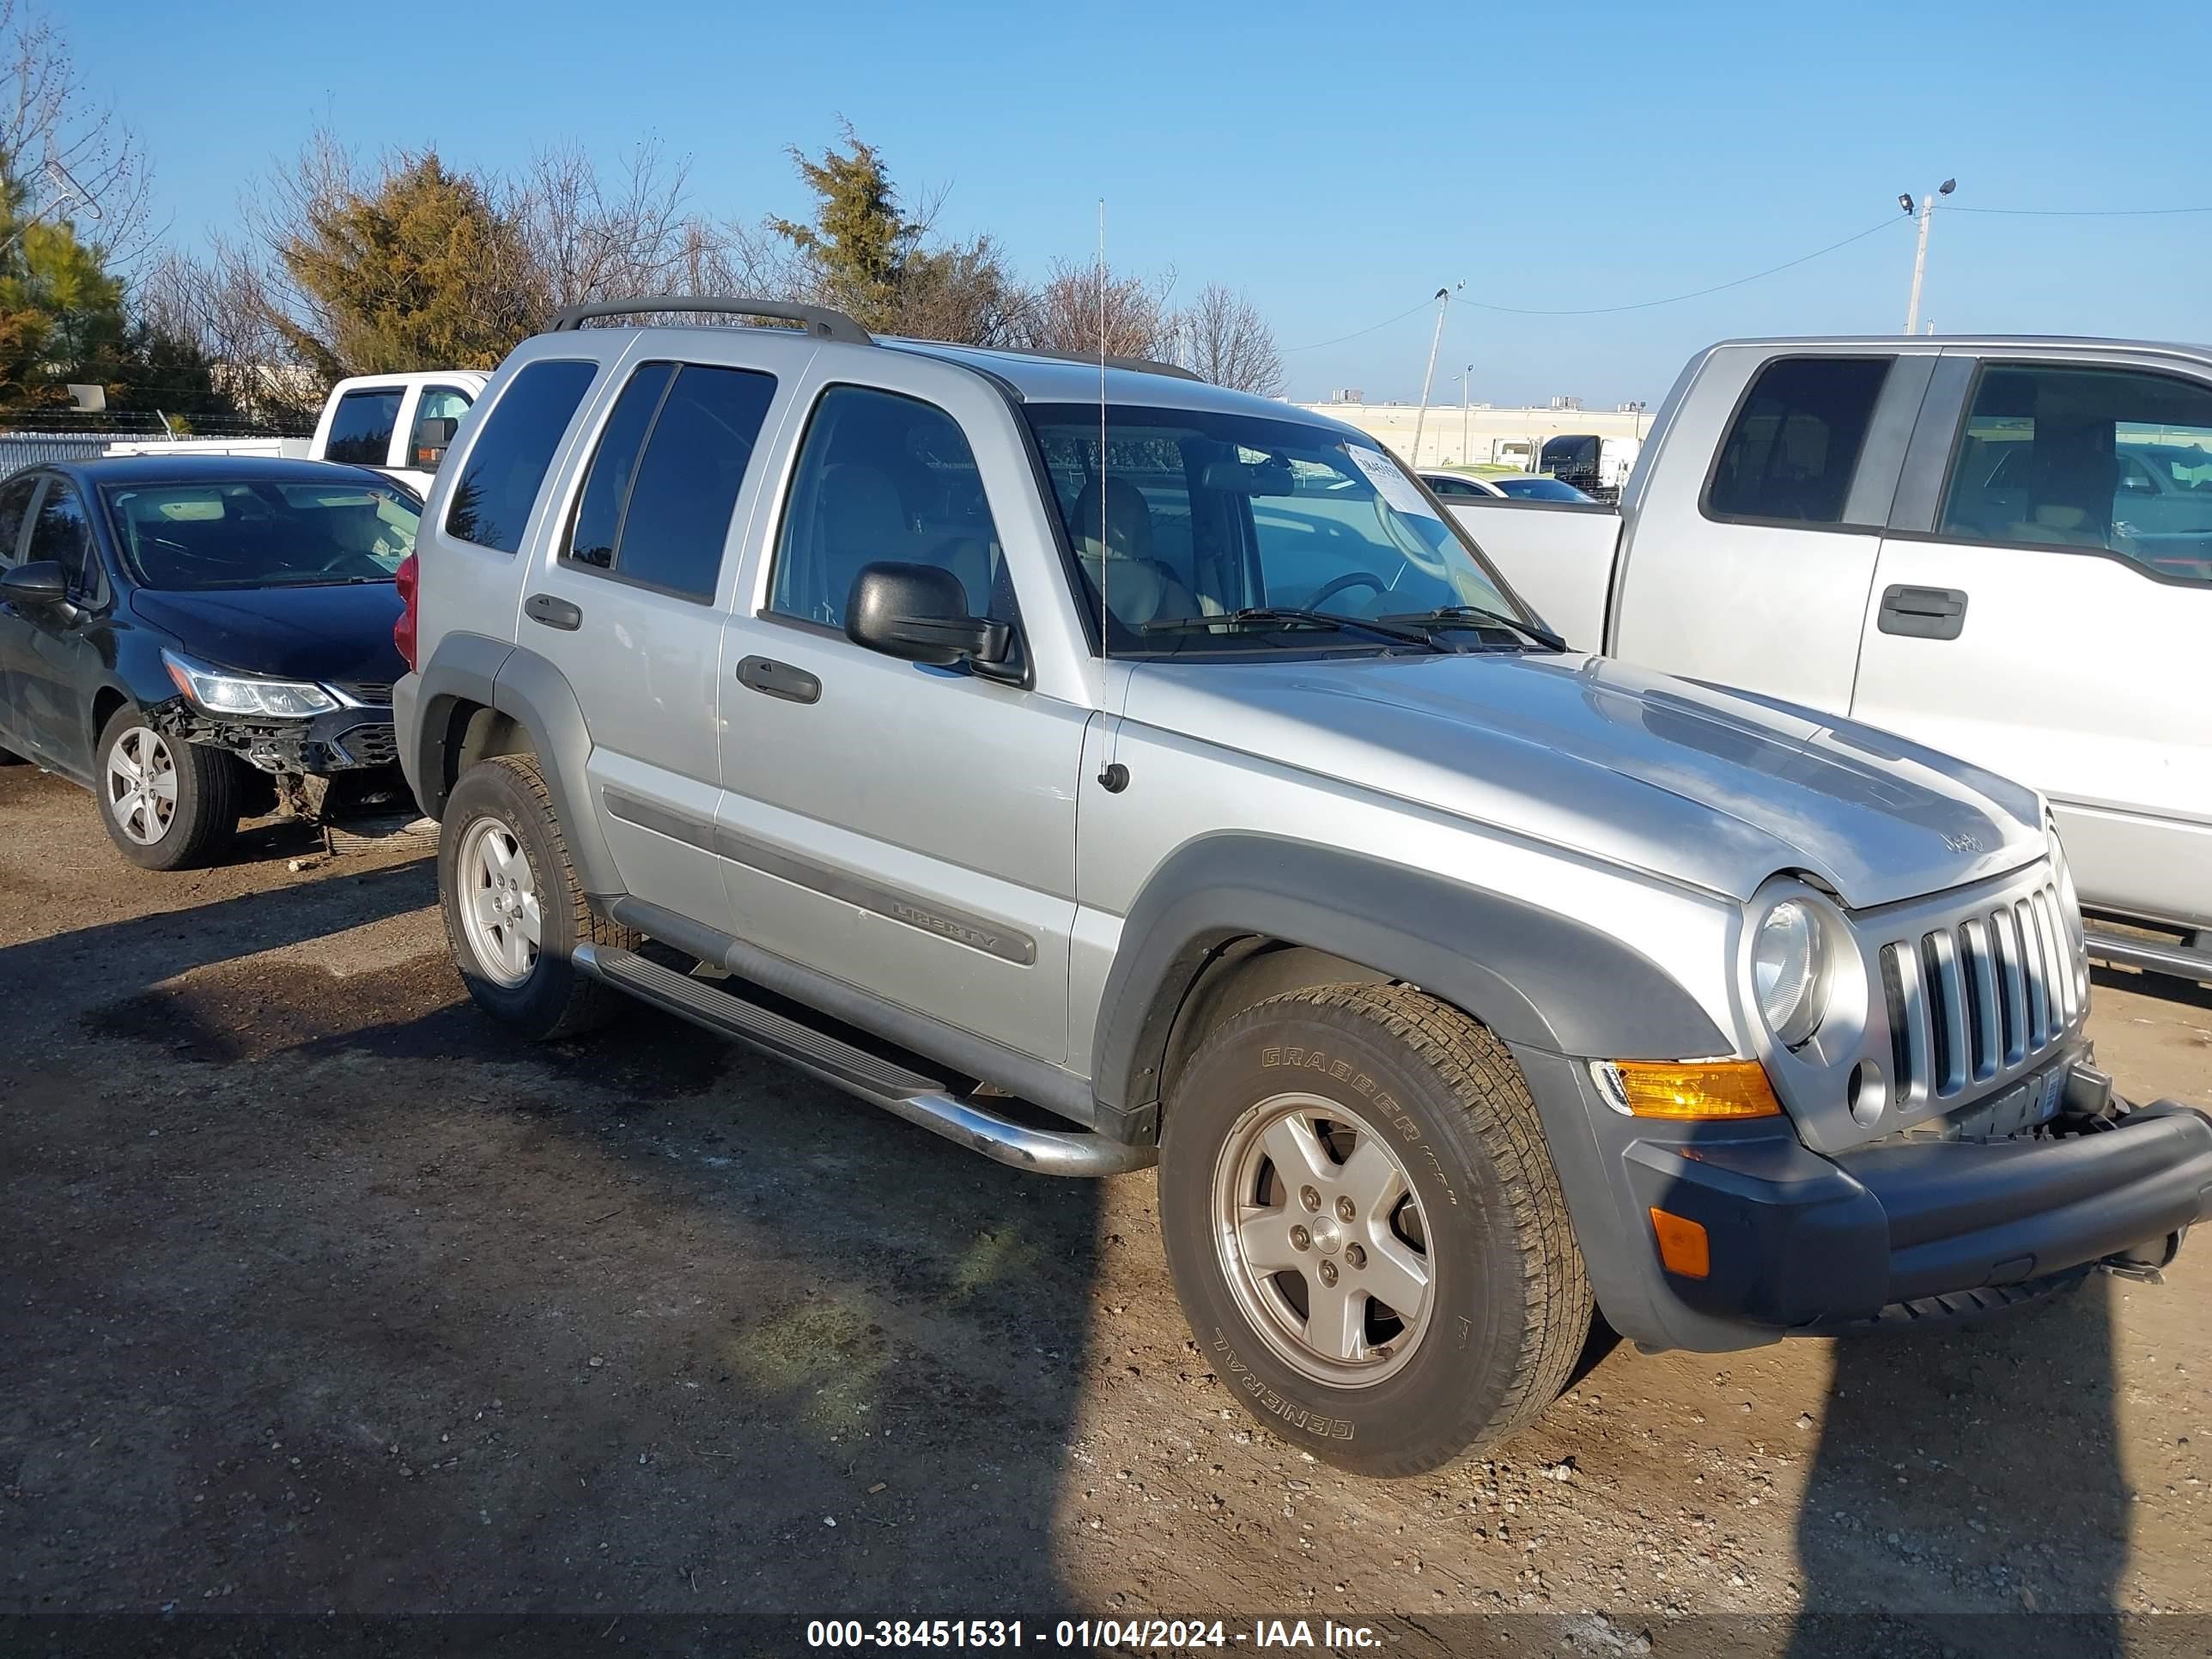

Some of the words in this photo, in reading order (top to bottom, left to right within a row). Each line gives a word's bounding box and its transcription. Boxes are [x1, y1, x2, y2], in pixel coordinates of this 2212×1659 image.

[894, 902, 997, 947] LIBERTY
[1261, 1047, 1422, 1142] GRABBER
[1212, 1327, 1356, 1441] GENERAL
